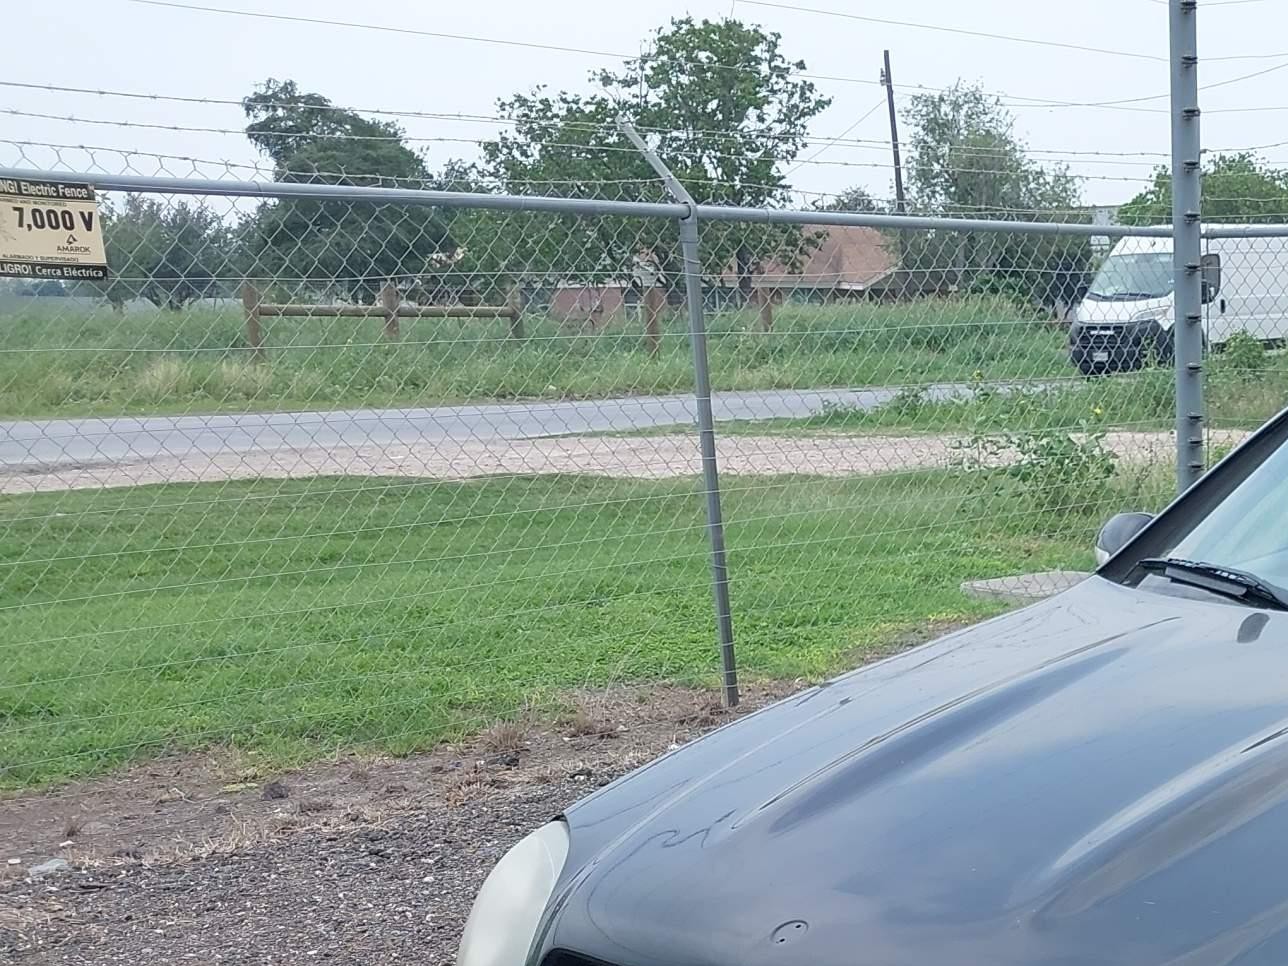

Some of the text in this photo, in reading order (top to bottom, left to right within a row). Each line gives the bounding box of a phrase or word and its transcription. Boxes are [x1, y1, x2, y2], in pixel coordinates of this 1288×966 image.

[21, 181, 57, 196] Electric
[59, 184, 88, 198] Fence
[12, 206, 94, 232] 7,000 V
[56, 245, 91, 253] AMAROK
[35, 265, 61, 276] Cerca
[63, 266, 104, 277] Eléctrica
